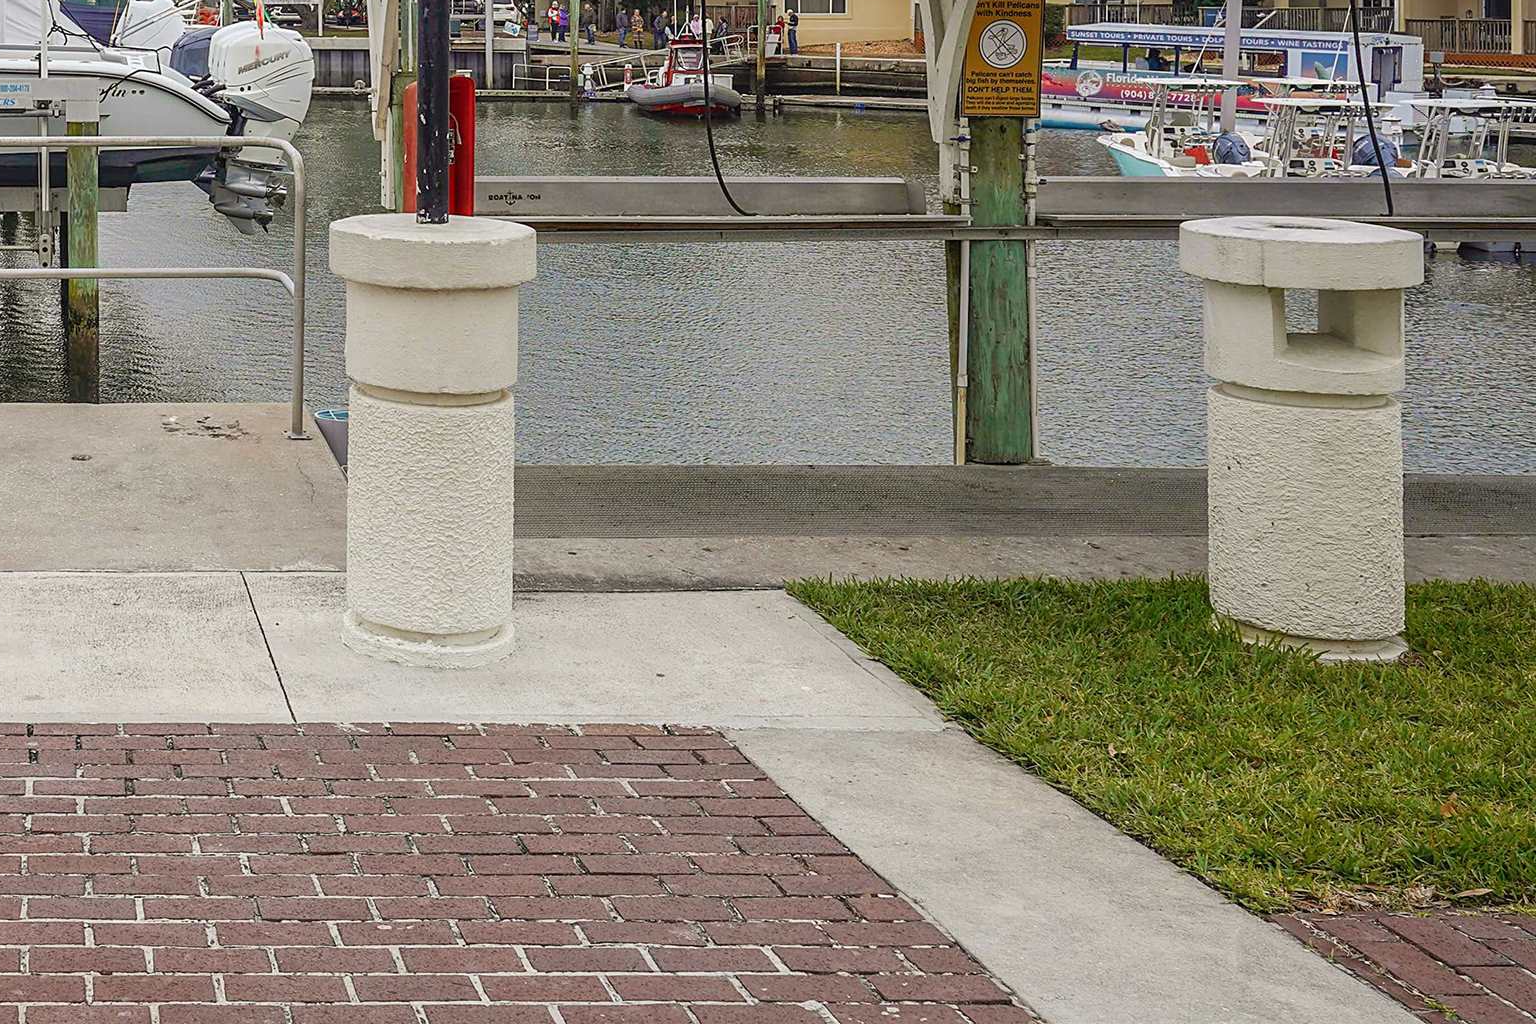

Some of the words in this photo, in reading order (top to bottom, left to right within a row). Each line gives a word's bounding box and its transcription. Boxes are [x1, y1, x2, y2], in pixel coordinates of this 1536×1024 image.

[976, 0, 990, 9] on't
[992, 0, 1005, 9] Kill
[1007, 0, 1040, 9] Pelicans
[1071, 31, 1098, 39] SUNSET
[1100, 31, 1125, 39] TOURS
[1133, 33, 1164, 41] PRIVATE
[1167, 35, 1193, 43] TOURS
[1242, 37, 1270, 46] TOURS
[1277, 39, 1300, 47] WINE
[1302, 39, 1344, 50] TASTINGS
[237, 51, 291, 75] MERCURY
[991, 86, 1010, 94] HELP
